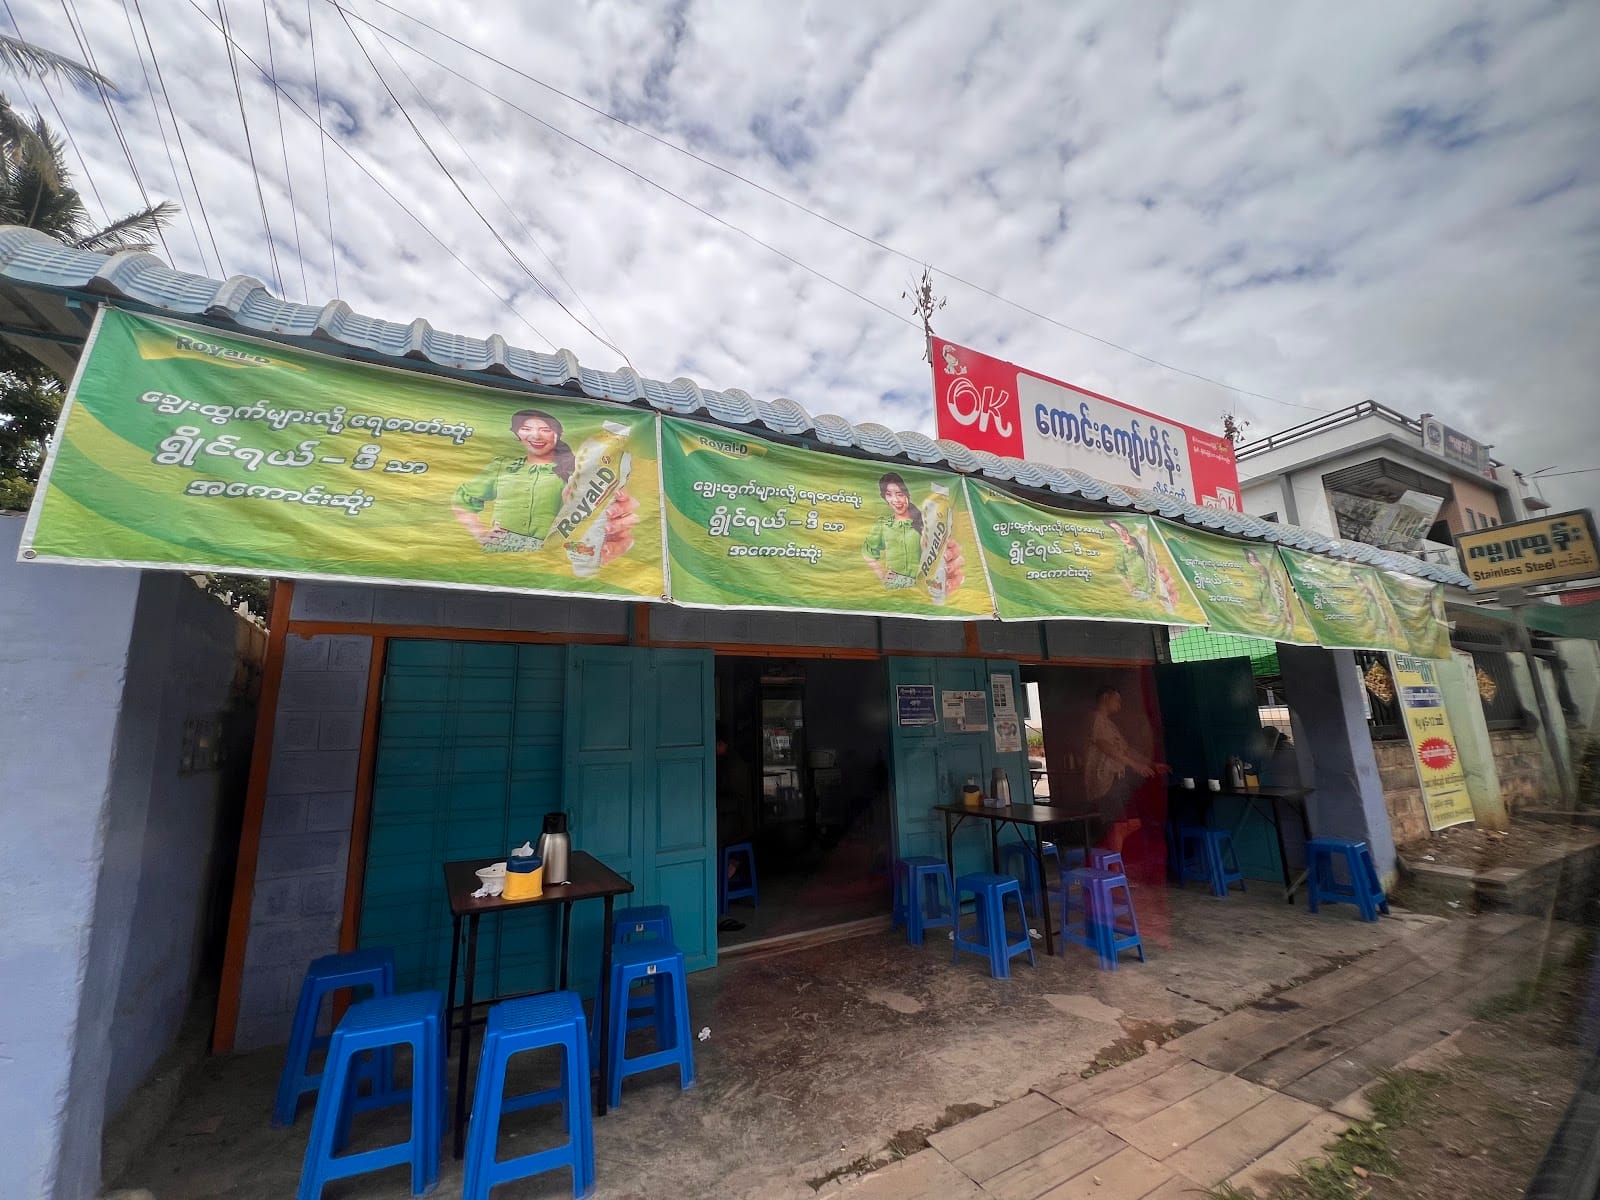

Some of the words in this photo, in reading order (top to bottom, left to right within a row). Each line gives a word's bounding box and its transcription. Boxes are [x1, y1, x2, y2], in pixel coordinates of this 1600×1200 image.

[946, 377, 1013, 438] OK
[698, 437, 749, 455] Royal-D
[1034, 402, 1182, 485] ကောင်းကျော်ဟိန်း
[187, 479, 374, 515] အကောင်းဆုံး
[556, 467, 616, 539] Royal-D
[921, 522, 946, 577] Royal-D
[1473, 564, 1523, 581] Stainless
[1525, 559, 1556, 573] Steel
